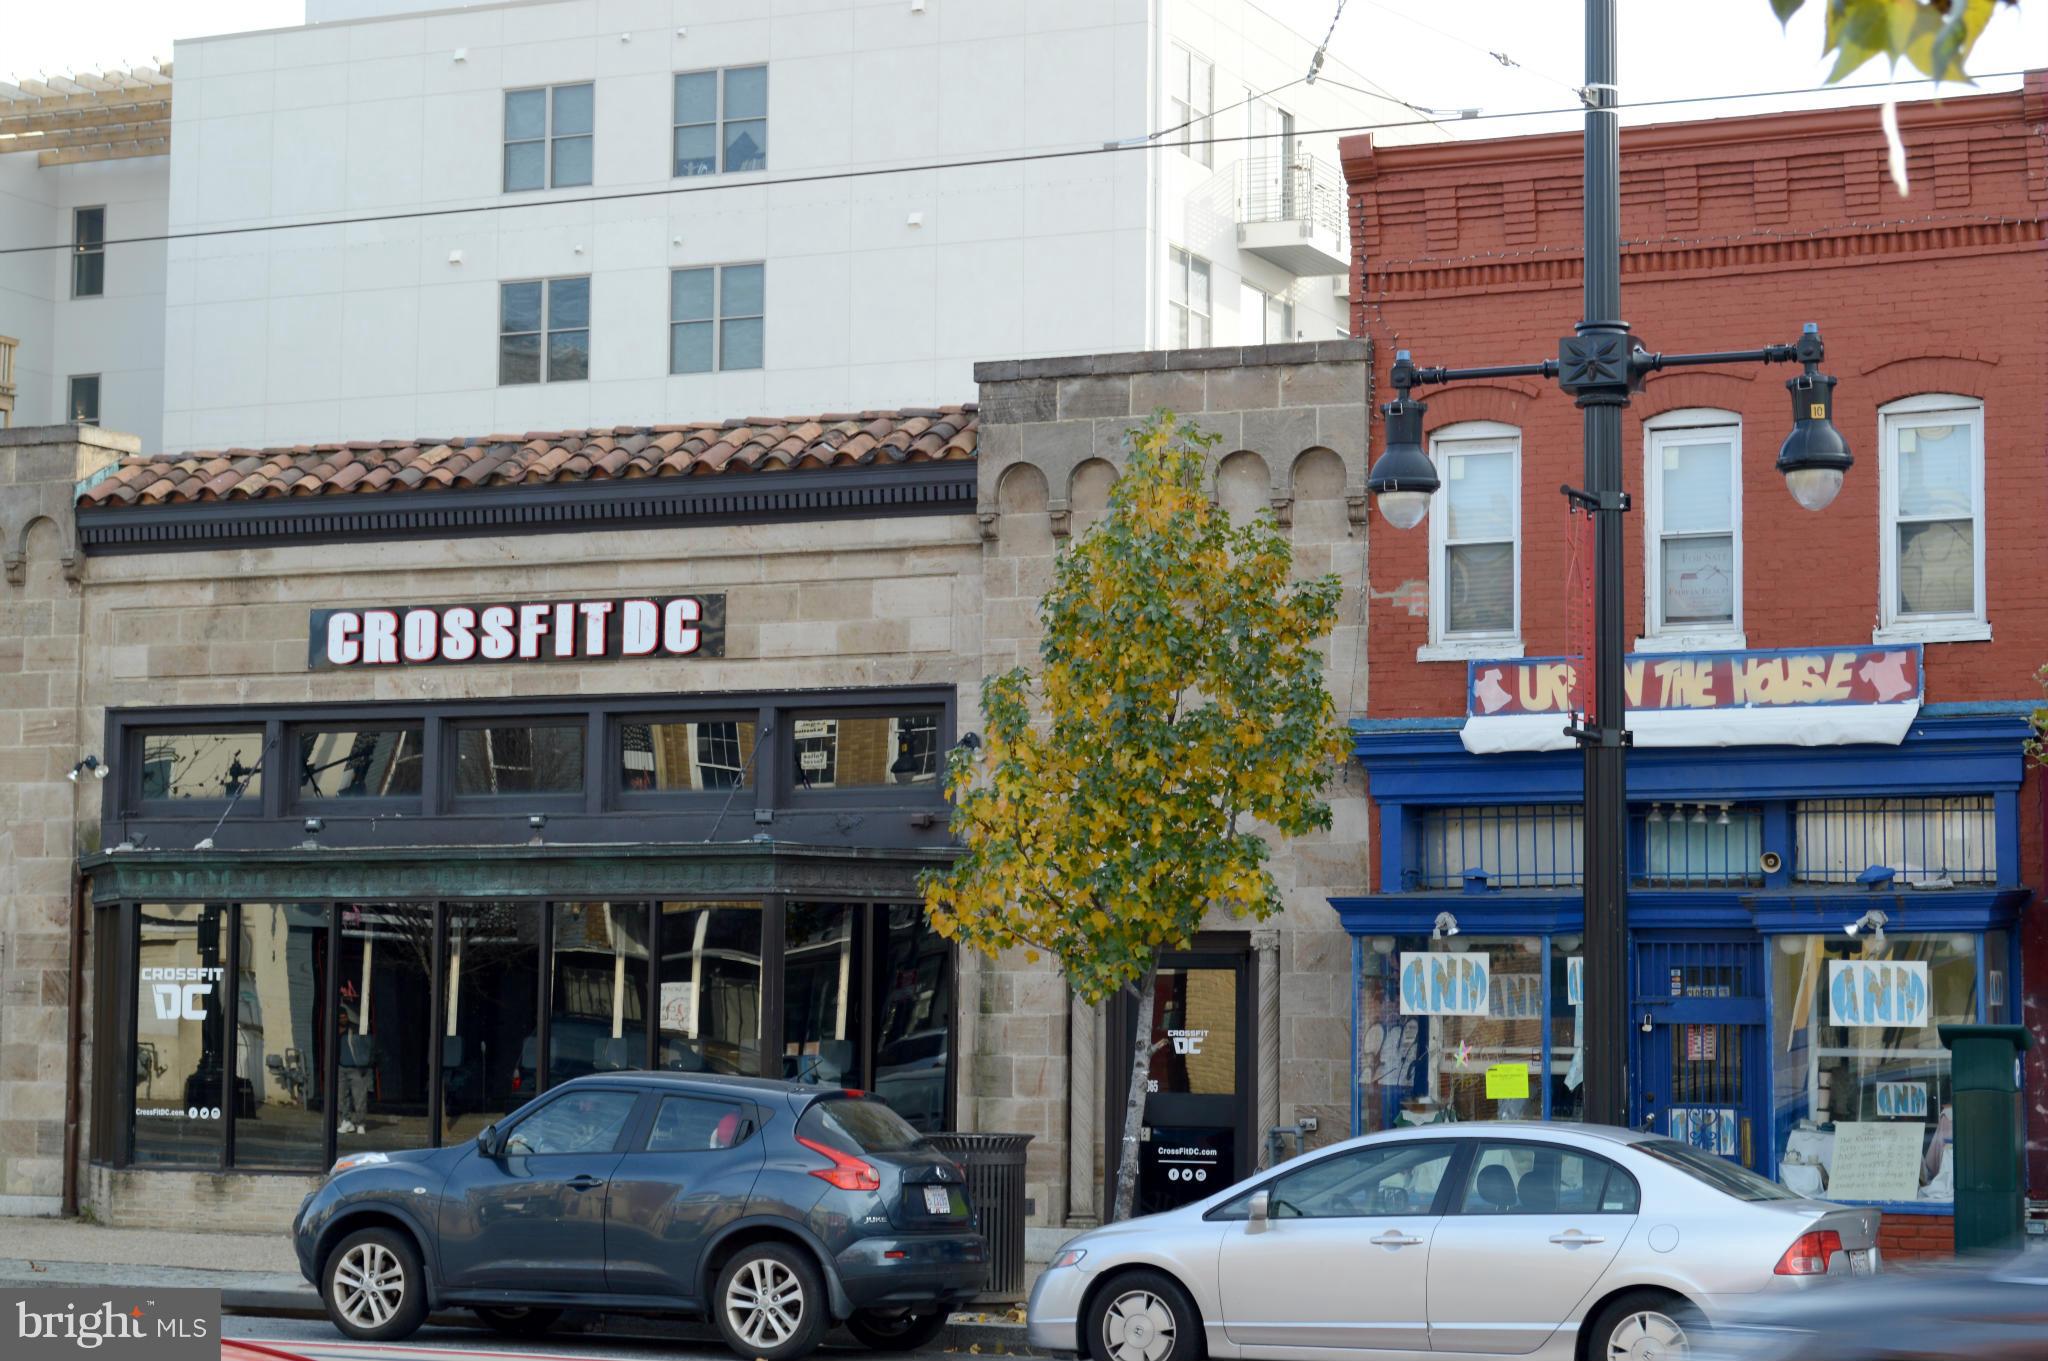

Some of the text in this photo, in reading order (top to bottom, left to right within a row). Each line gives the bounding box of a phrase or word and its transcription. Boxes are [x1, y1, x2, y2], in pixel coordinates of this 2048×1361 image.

[1814, 406, 1823, 417] 10
[327, 599, 701, 665] CROSSFIT DC
[1655, 659, 1717, 708] THE
[1730, 652, 1858, 705] HOUSE
[142, 967, 224, 981] CROSSFIT
[152, 984, 212, 1020] DC
[1168, 1029, 1209, 1037] CROSSFIT
[1173, 1037, 1204, 1054] DC
[136, 1107, 185, 1116] CrossFitDC.com
[1158, 1147, 1217, 1156] CrossFitDC.com
[864, 1217, 888, 1225] JUKE
